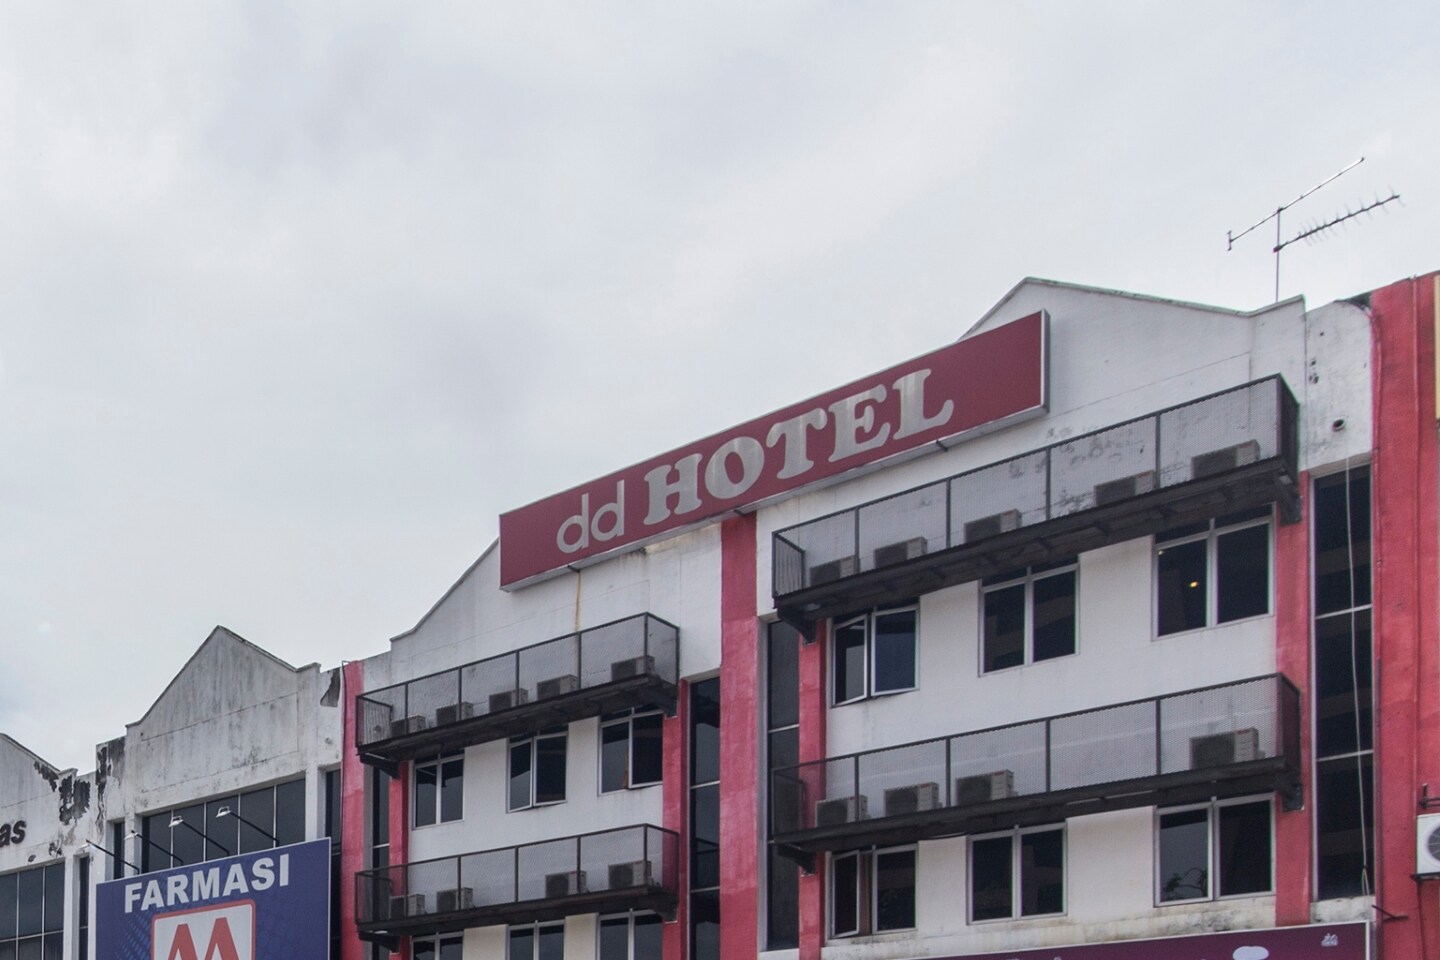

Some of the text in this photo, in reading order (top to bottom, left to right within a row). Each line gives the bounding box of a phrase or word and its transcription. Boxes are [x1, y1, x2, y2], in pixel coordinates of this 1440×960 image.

[556, 369, 955, 554] dd HOTEL
[125, 854, 289, 913] FARMASI
